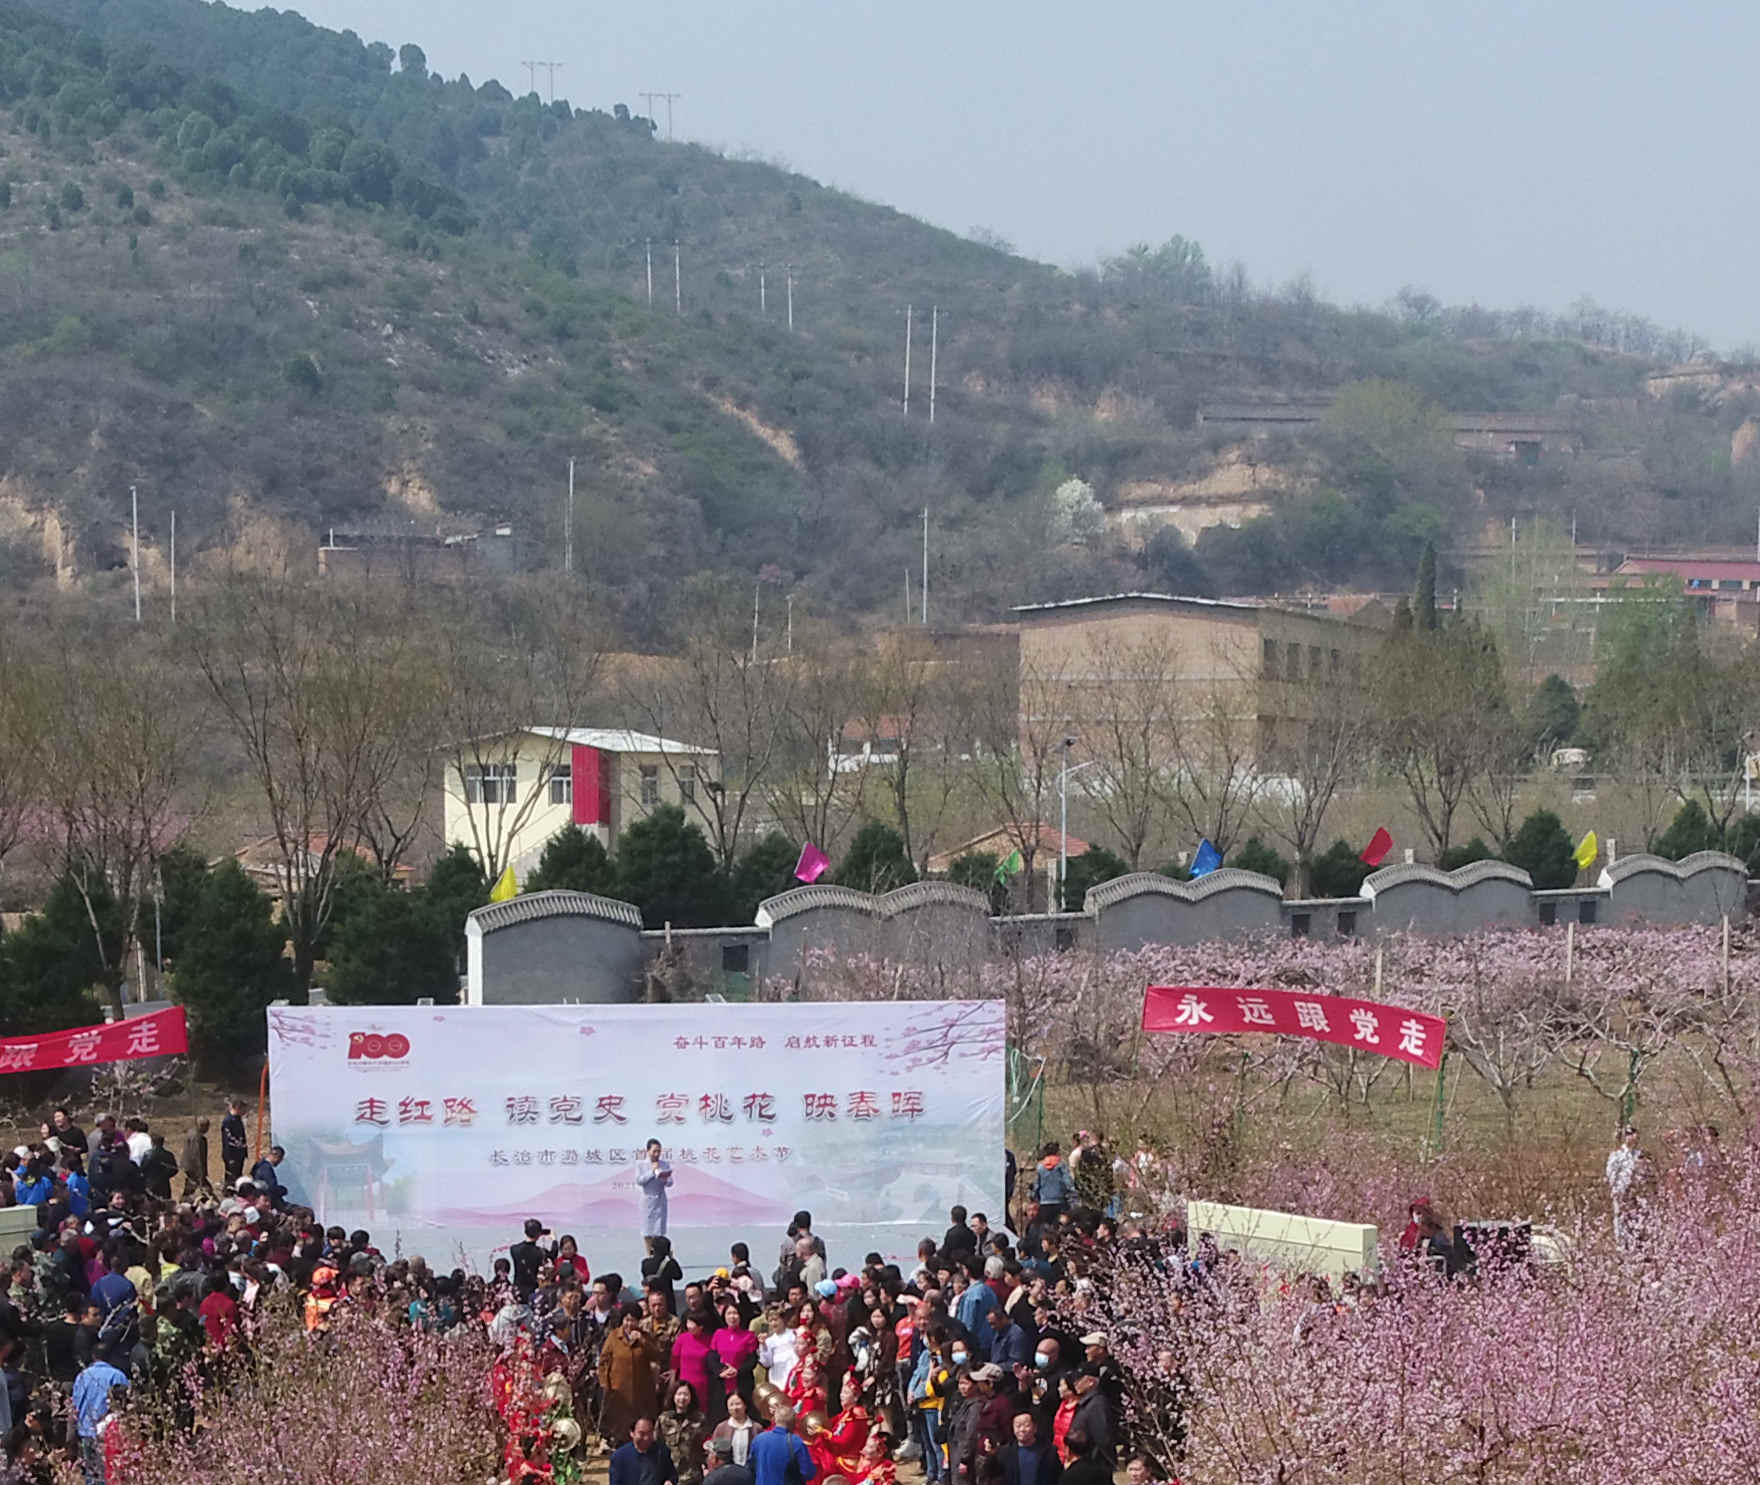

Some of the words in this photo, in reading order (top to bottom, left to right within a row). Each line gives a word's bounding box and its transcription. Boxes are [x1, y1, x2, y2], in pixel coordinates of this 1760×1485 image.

[1175, 994, 1427, 1056] 永远跟党走
[347, 1032, 410, 1059] 100
[673, 1035, 767, 1050] 奋斗百年路
[784, 1034, 878, 1049] 启航新征程
[354, 1096, 477, 1125] 走红路
[506, 1095, 627, 1123] 读党史
[655, 1092, 777, 1122] 赏桃花
[802, 1090, 924, 1119] 映春晖
